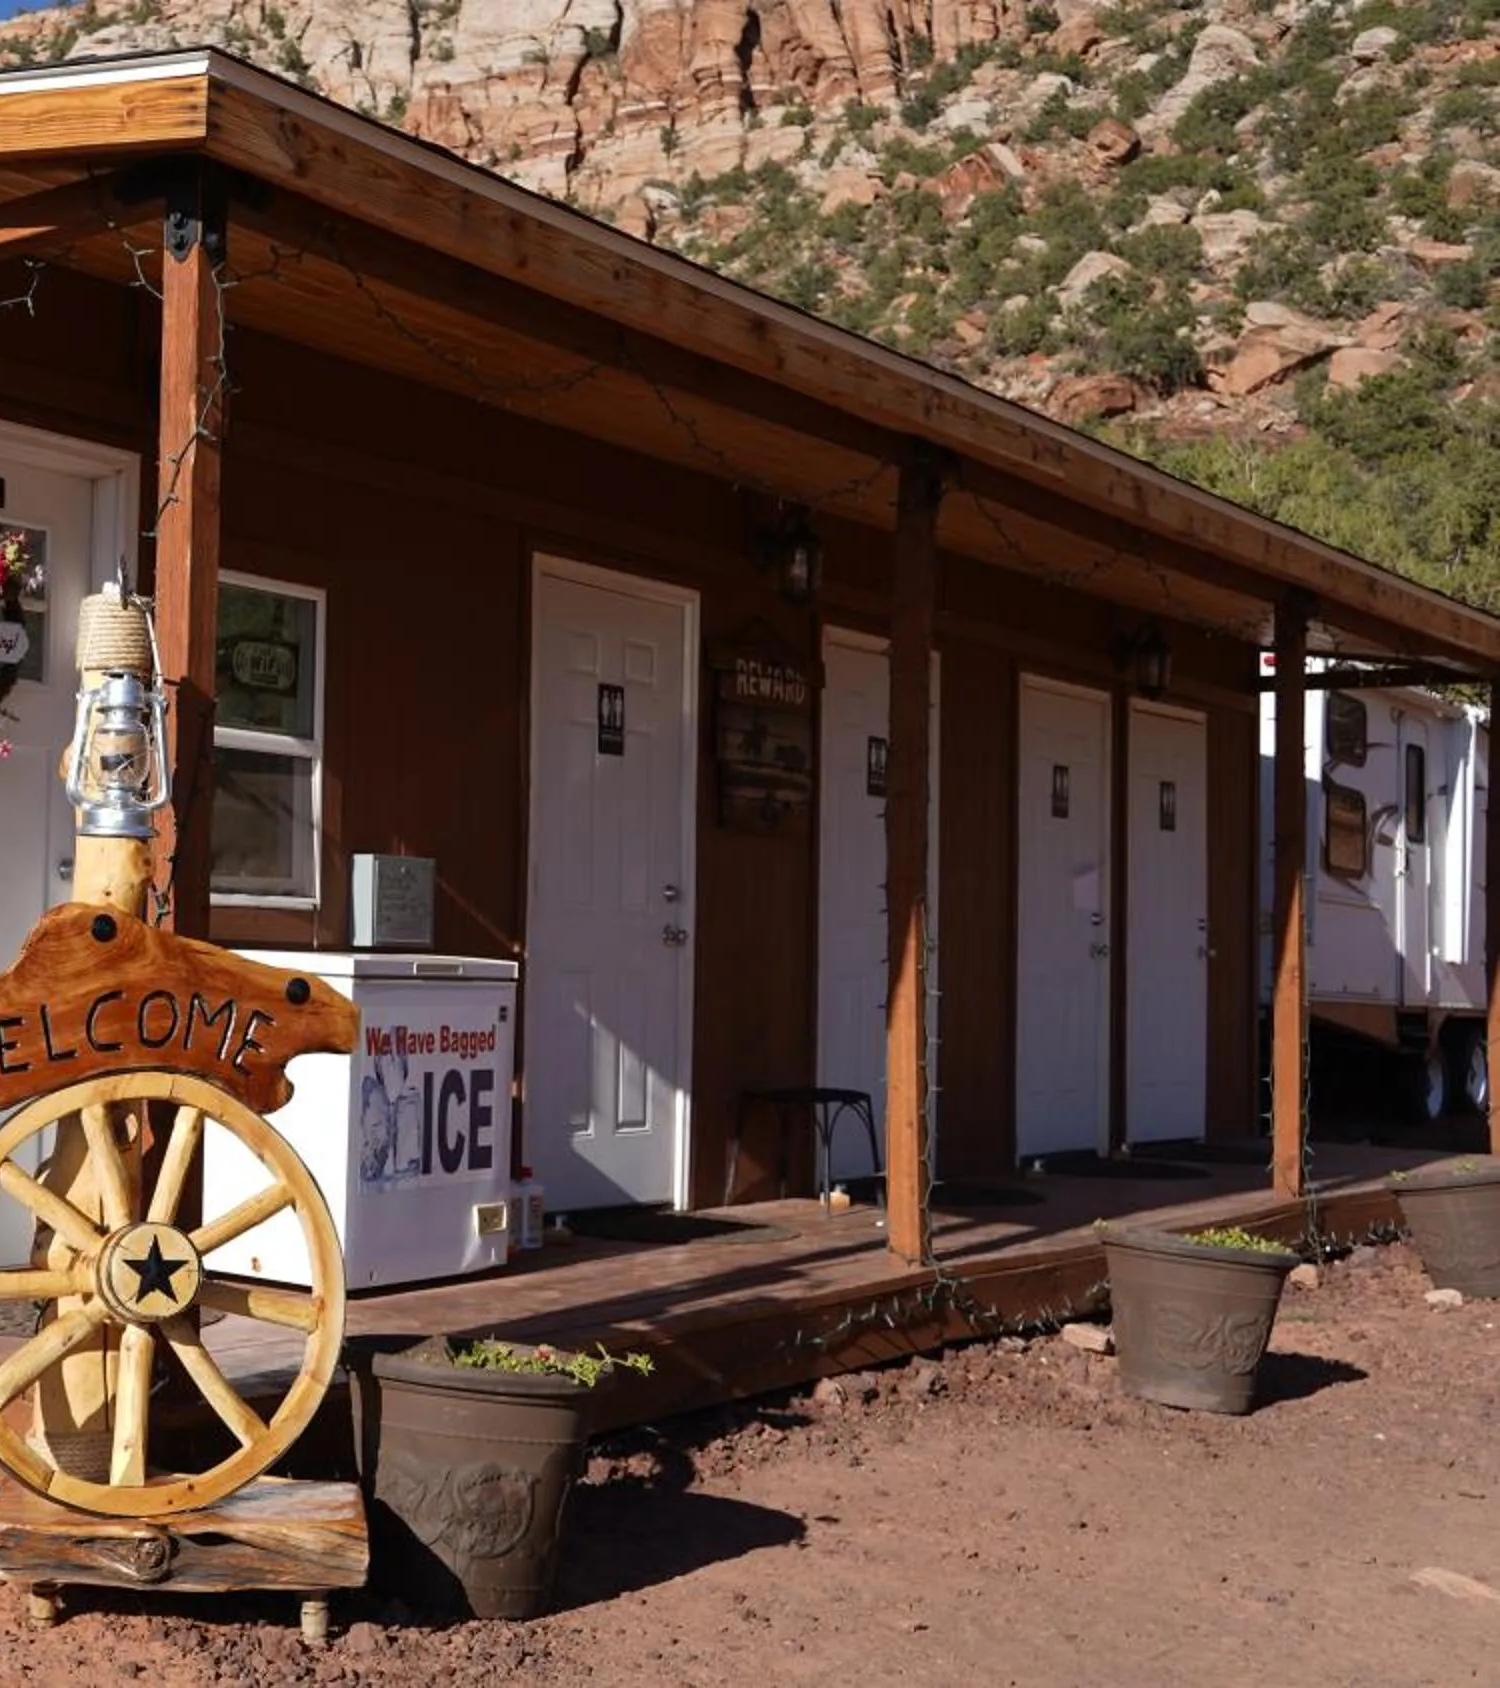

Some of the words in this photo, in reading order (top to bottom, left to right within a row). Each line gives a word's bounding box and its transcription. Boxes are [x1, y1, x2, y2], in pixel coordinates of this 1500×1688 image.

[736, 658, 806, 704] REWARD
[366, 1026, 391, 1056] We
[396, 1025, 435, 1056] Have
[440, 1024, 496, 1060] Bagged
[421, 1069, 494, 1175] ICE
